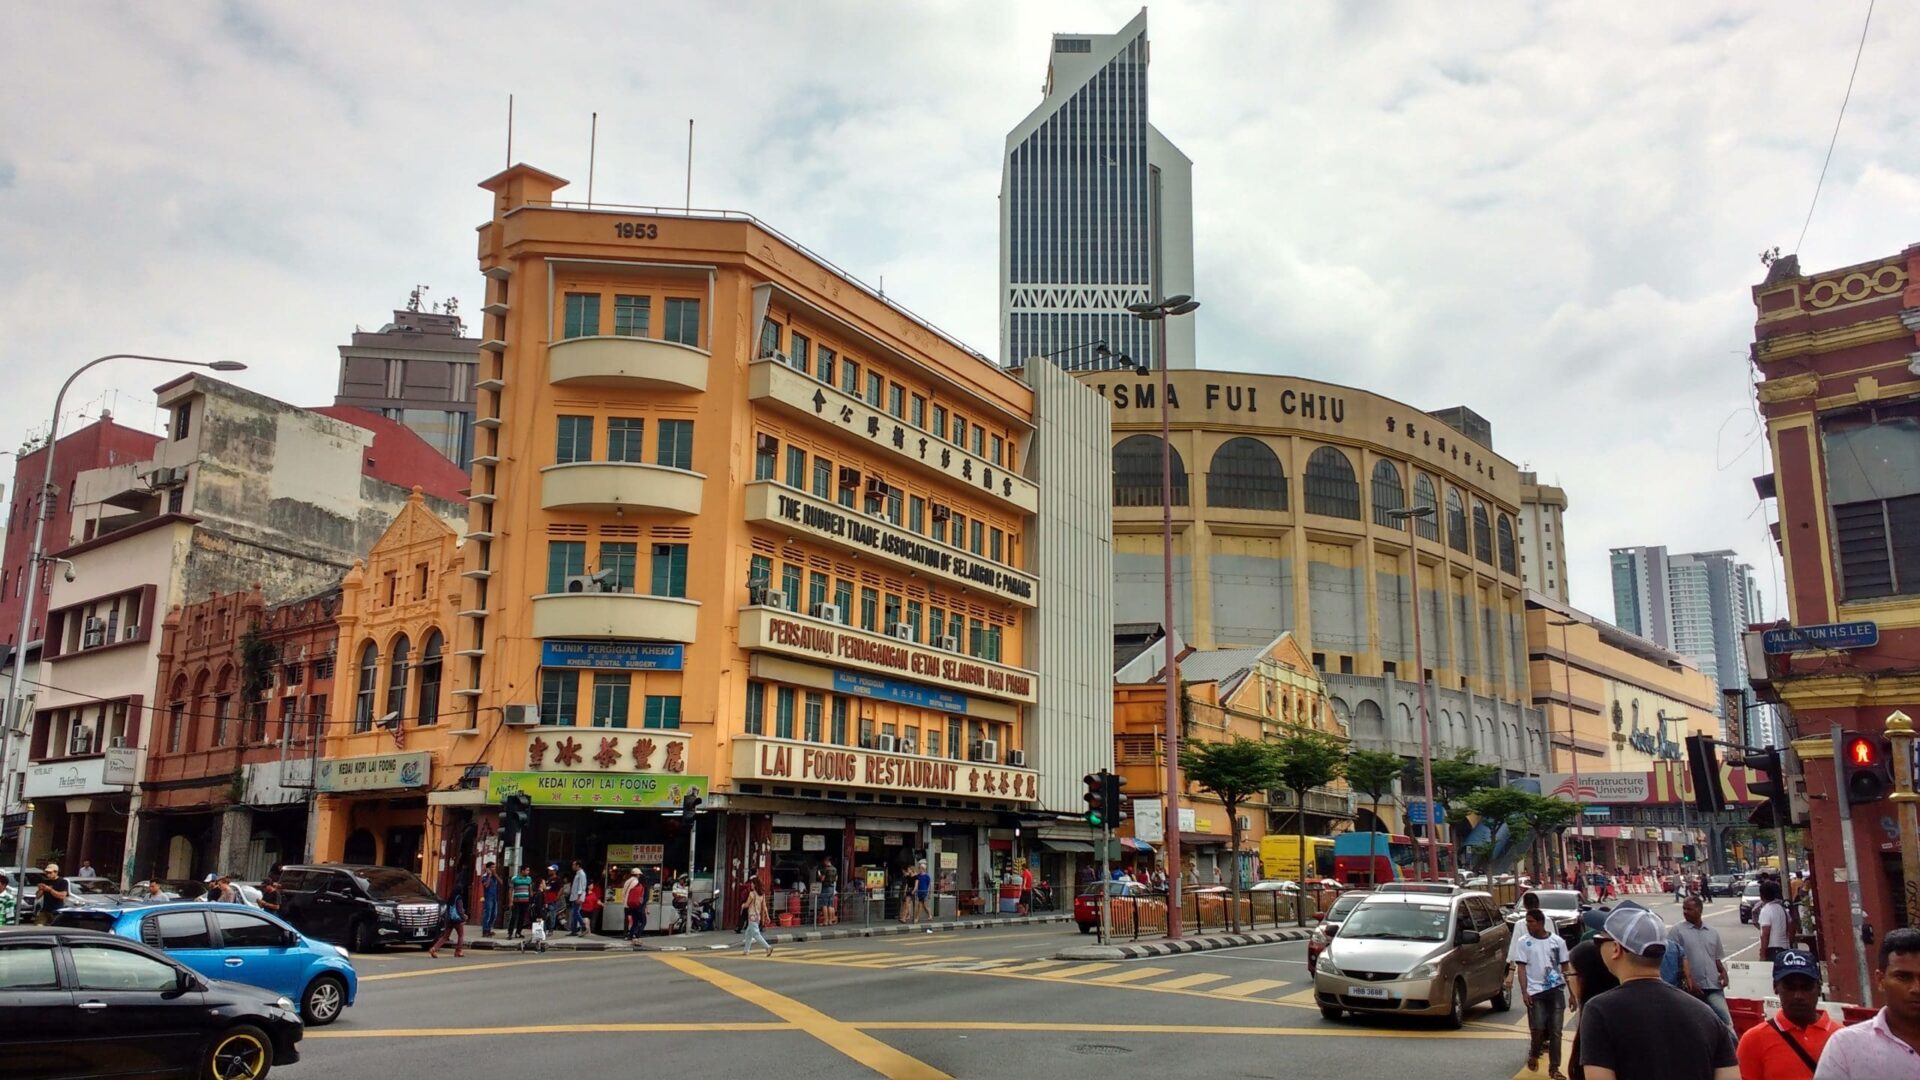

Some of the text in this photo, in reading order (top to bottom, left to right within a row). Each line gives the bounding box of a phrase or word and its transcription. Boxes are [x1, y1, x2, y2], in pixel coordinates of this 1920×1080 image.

[614, 221, 658, 240] 1953
[1086, 383, 1344, 423] ISMA FUI CHIU
[779, 494, 801, 522] THE
[803, 503, 845, 537] RUBBER
[847, 518, 881, 549] TRADE
[881, 531, 940, 569] ASSOCIATION
[940, 551, 952, 572] OF
[953, 555, 995, 589] SELANGOR
[1003, 574, 1031, 600] PAHANG
[1768, 630, 1802, 643] JALAN
[1806, 627, 1826, 640] TUN
[551, 644, 674, 656] KLINIK PERGIGIAN KHENG
[769, 617, 834, 654] PERSATUAN
[838, 633, 908, 671] PERDAGANGAN
[911, 651, 940, 678] GETAH
[942, 659, 985, 687] SELANGOR
[987, 668, 1004, 692] DAN
[595, 659, 621, 667] DENTAL
[625, 660, 657, 668] SURGERY
[339, 759, 396, 775] KEDAI KOPI LAI FOONG
[761, 744, 958, 791] LAI FOONG RESTAURANT
[538, 777, 657, 790] KEDAI KOPI LAI FOONG
[1578, 777, 1644, 787] Infrastructure
[1596, 787, 1644, 796] University
